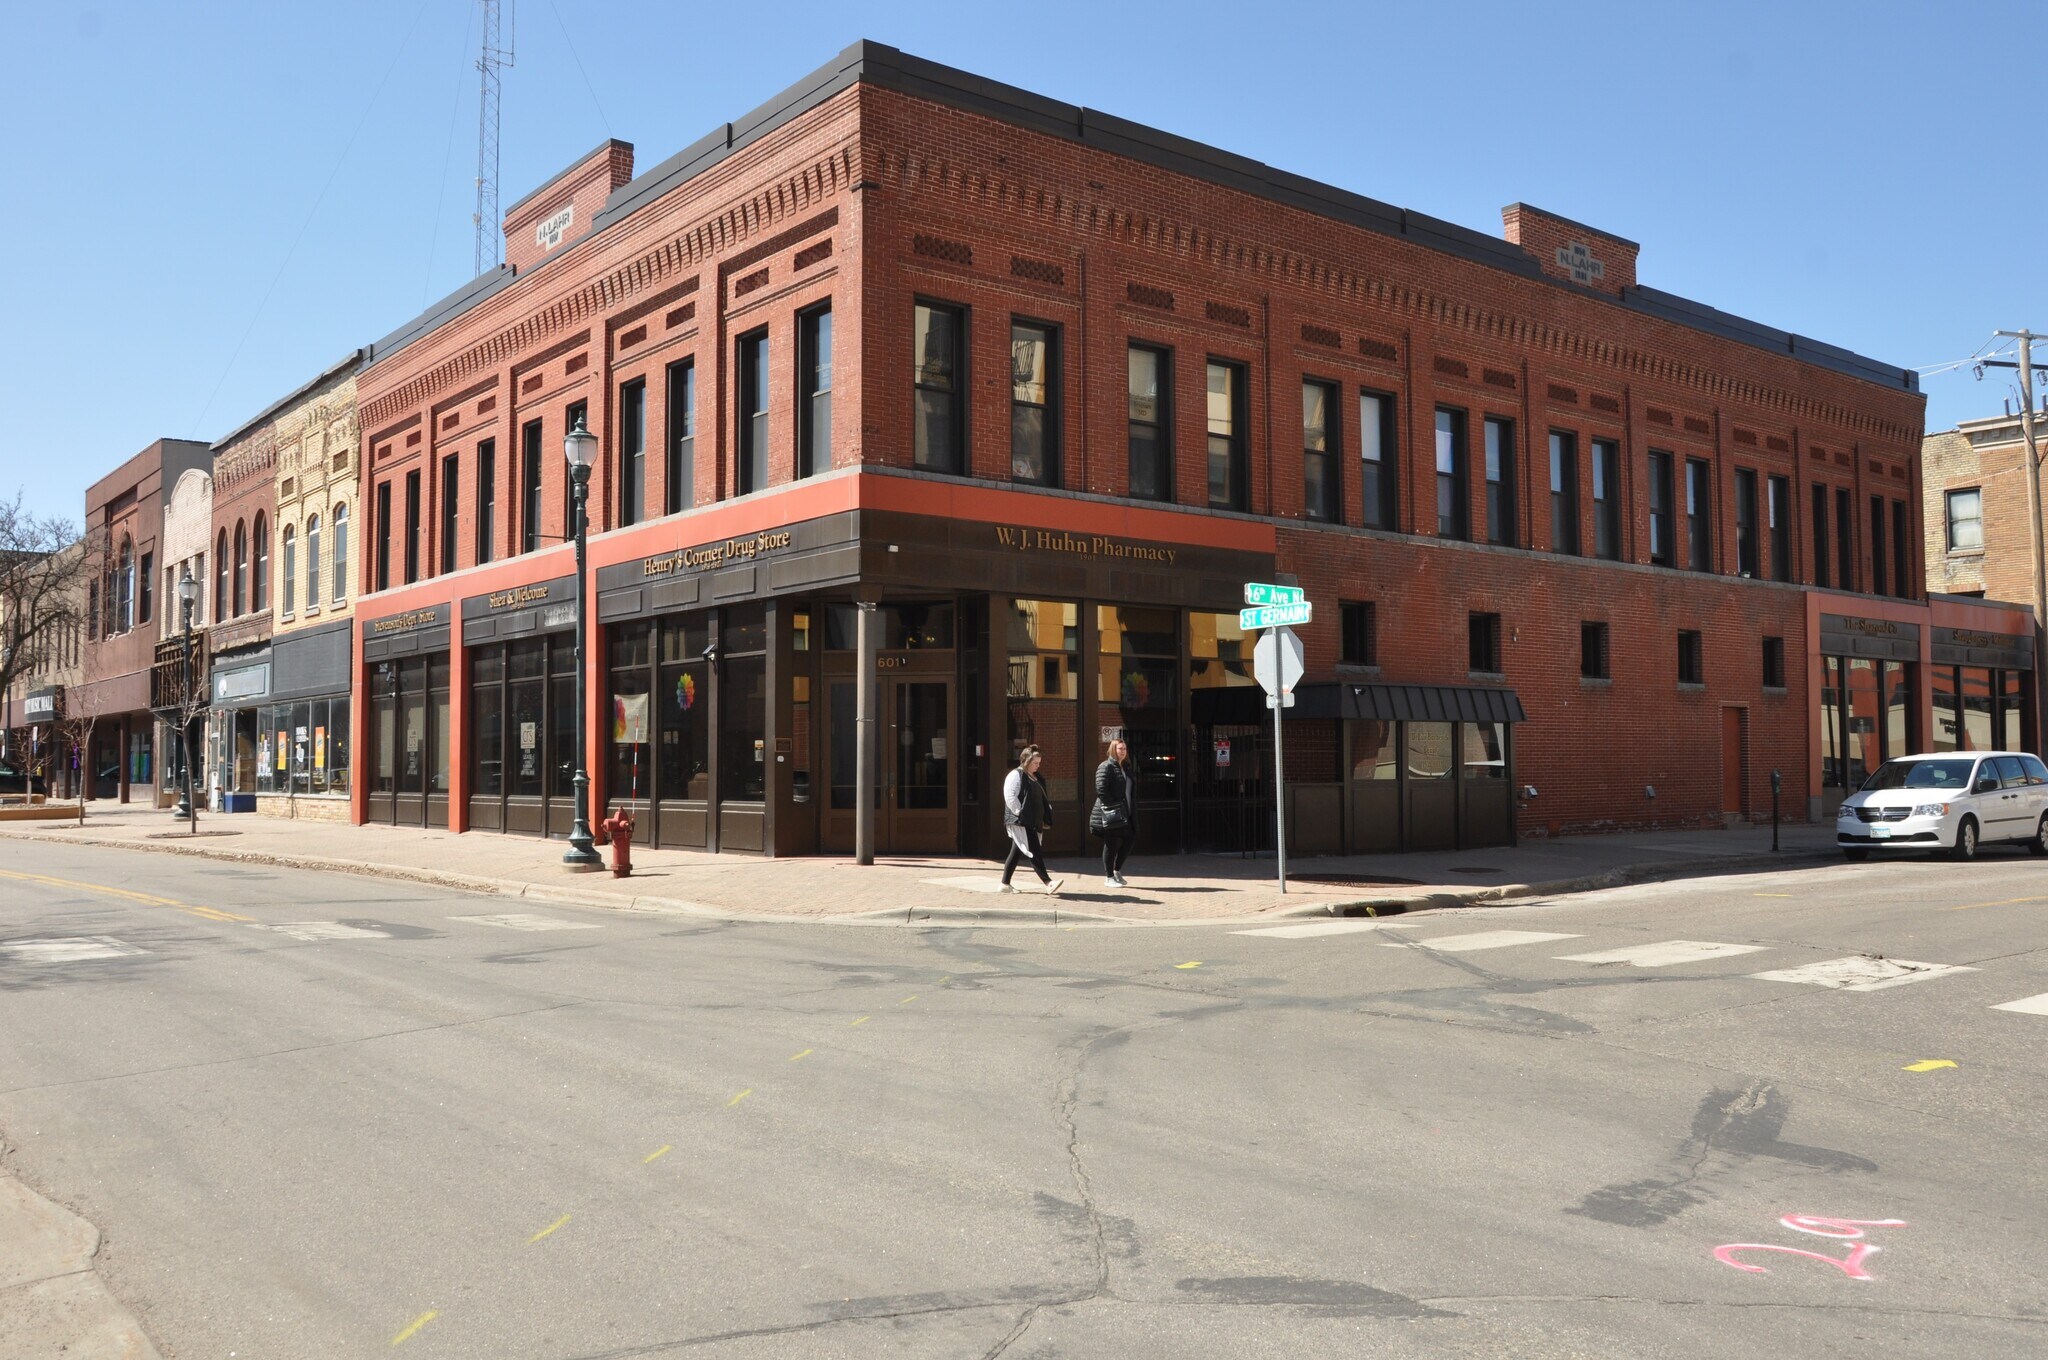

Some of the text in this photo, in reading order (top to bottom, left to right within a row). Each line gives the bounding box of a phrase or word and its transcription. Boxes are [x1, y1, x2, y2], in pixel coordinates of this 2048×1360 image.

[644, 553, 683, 575] Henry's
[684, 545, 724, 568] Corner
[726, 538, 756, 559] Drug
[757, 531, 790, 551] Store
[996, 527, 1176, 565] W. J. Huhn Pharmacy
[507, 591, 515, 605] &
[515, 586, 548, 603] Welcome
[1253, 587, 1265, 602] 6th
[1270, 588, 1288, 604] Ave
[1245, 605, 1304, 626] ST GERMAIN
